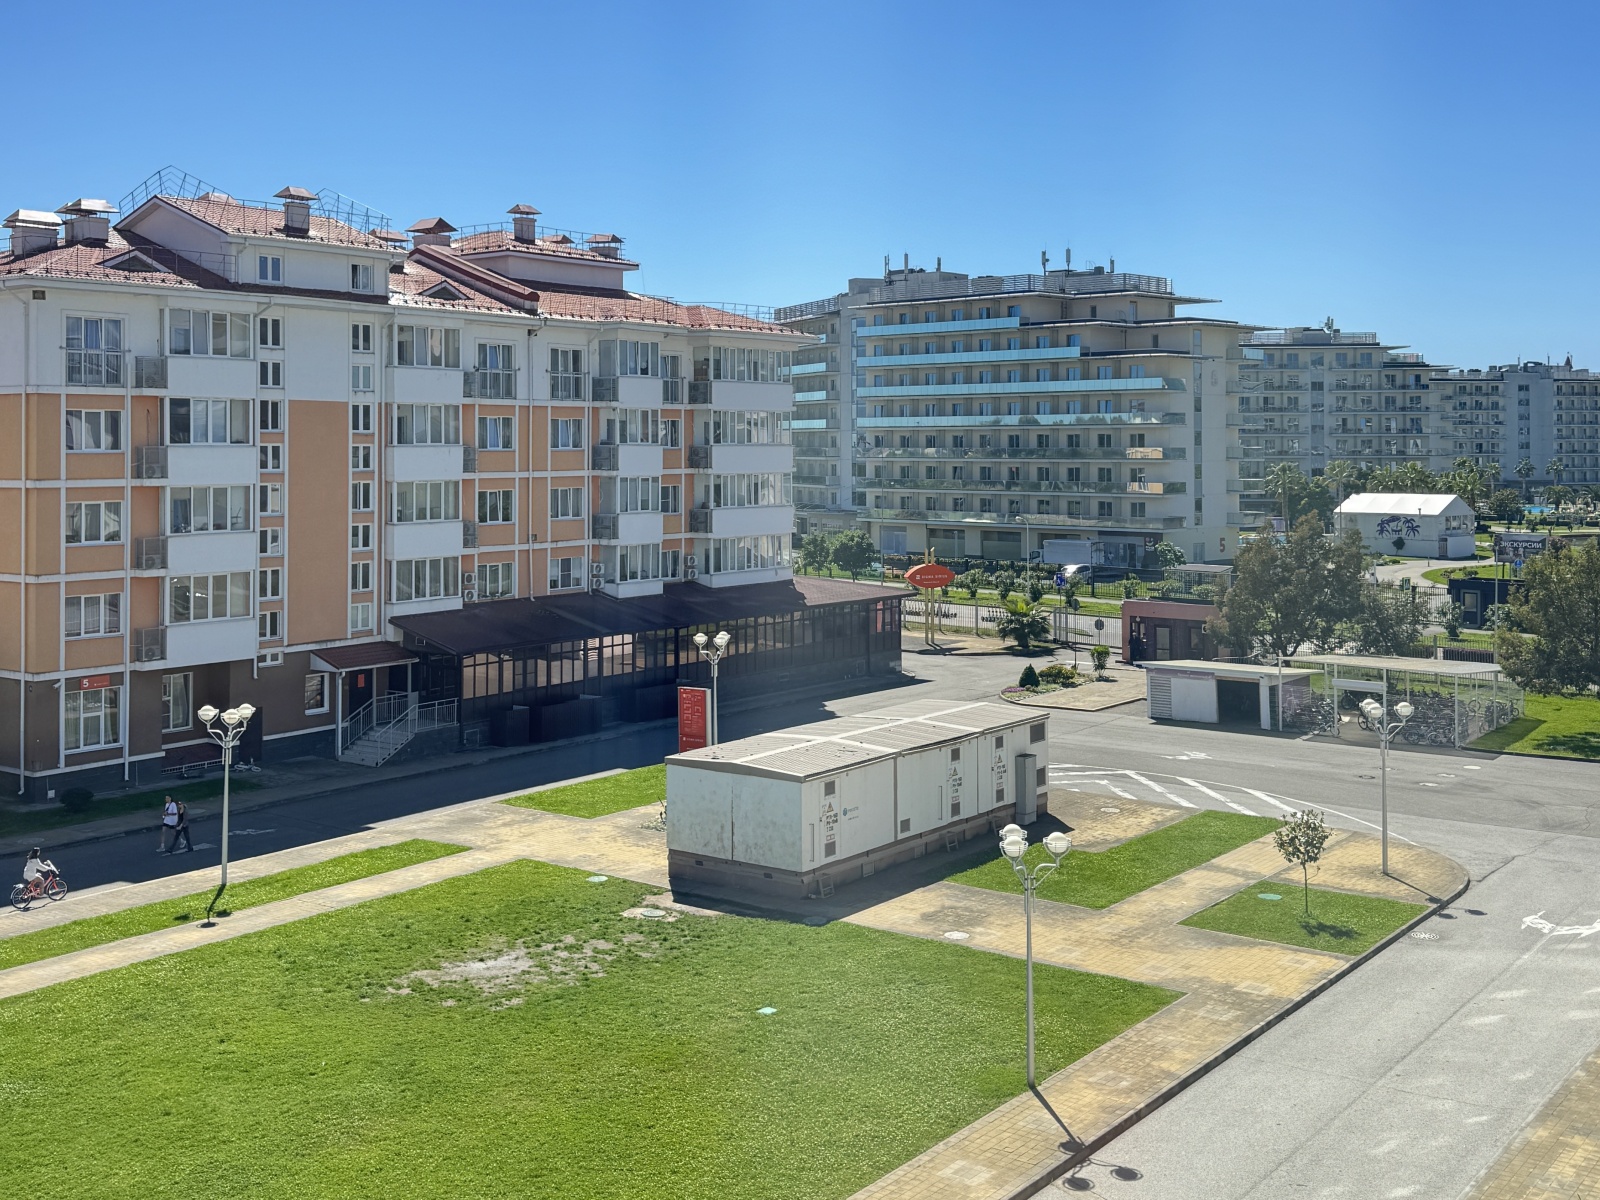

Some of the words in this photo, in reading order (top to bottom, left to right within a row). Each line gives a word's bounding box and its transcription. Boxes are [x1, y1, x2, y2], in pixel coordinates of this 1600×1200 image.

[1219, 537, 1226, 553] 5
[1500, 541, 1542, 549] ЭКСКУРСИИ
[83, 679, 89, 688] 5
